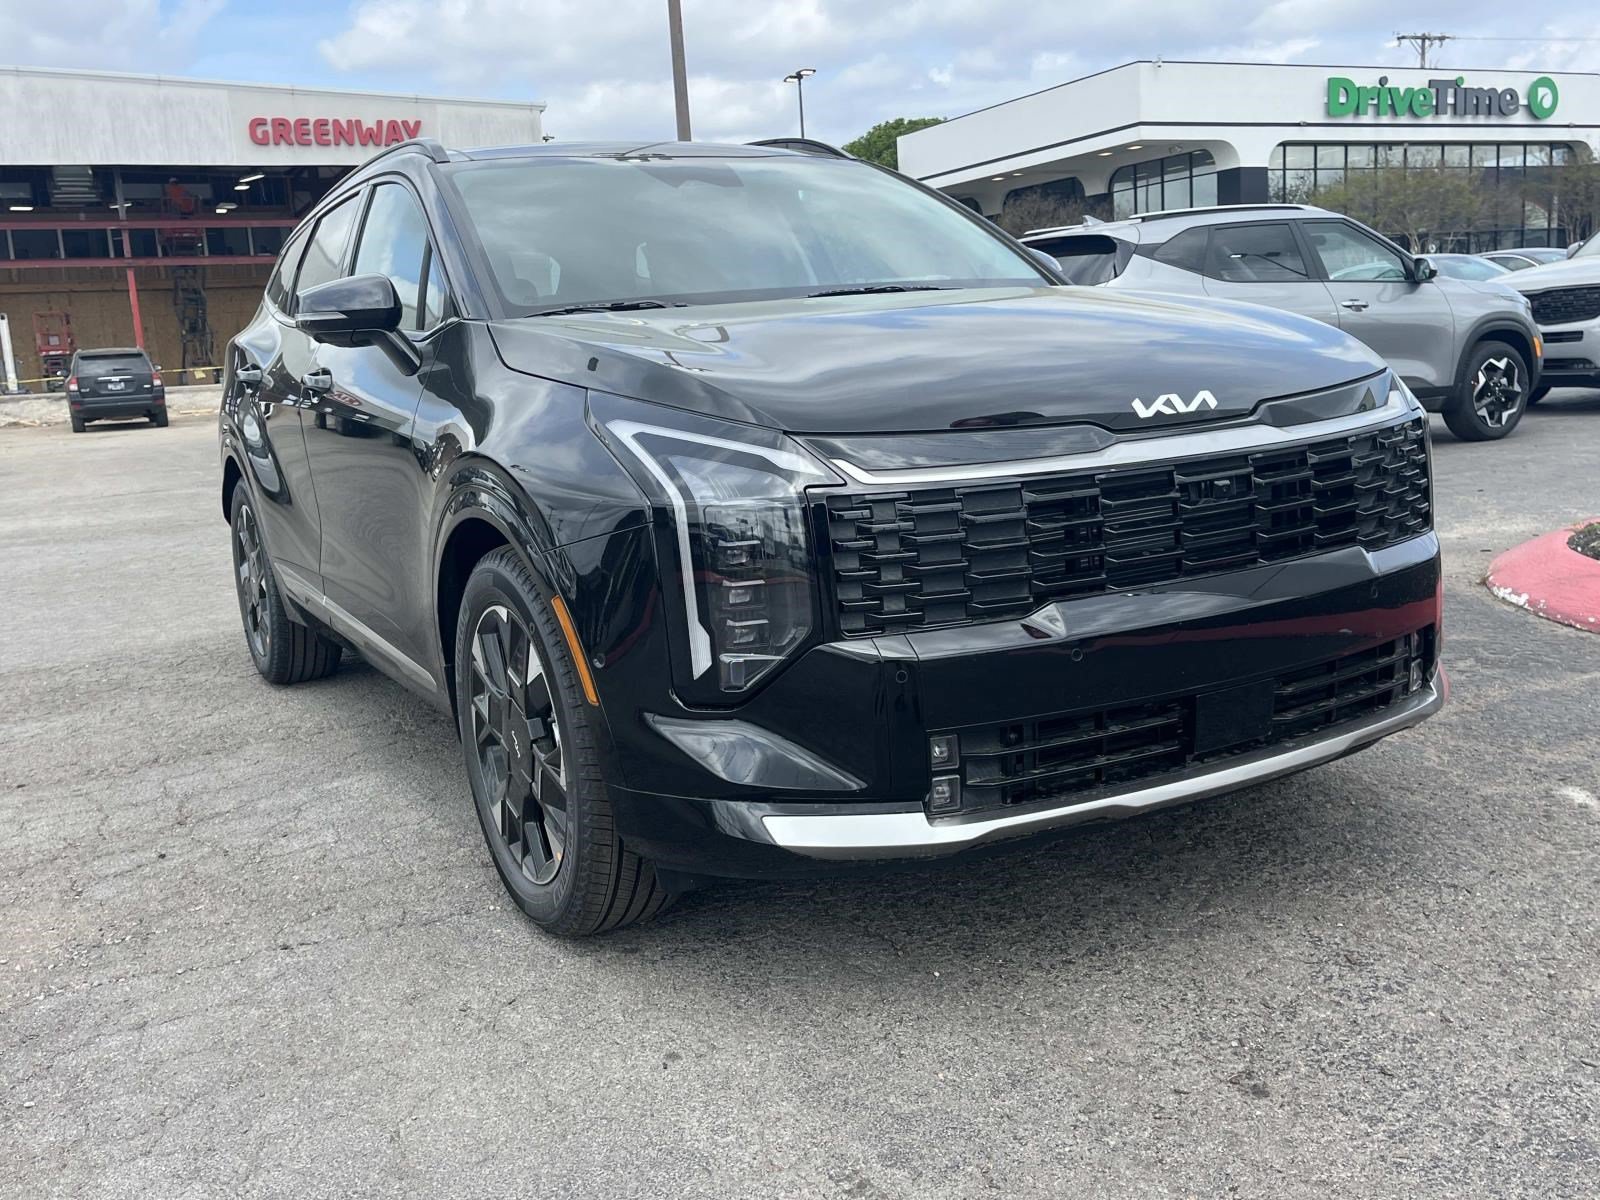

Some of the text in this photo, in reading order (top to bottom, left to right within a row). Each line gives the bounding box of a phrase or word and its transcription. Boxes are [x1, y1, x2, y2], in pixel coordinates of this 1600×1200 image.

[1327, 76, 1520, 117] DriveTime
[249, 117, 422, 146] GREENWAY
[1131, 390, 1218, 418] KIA
